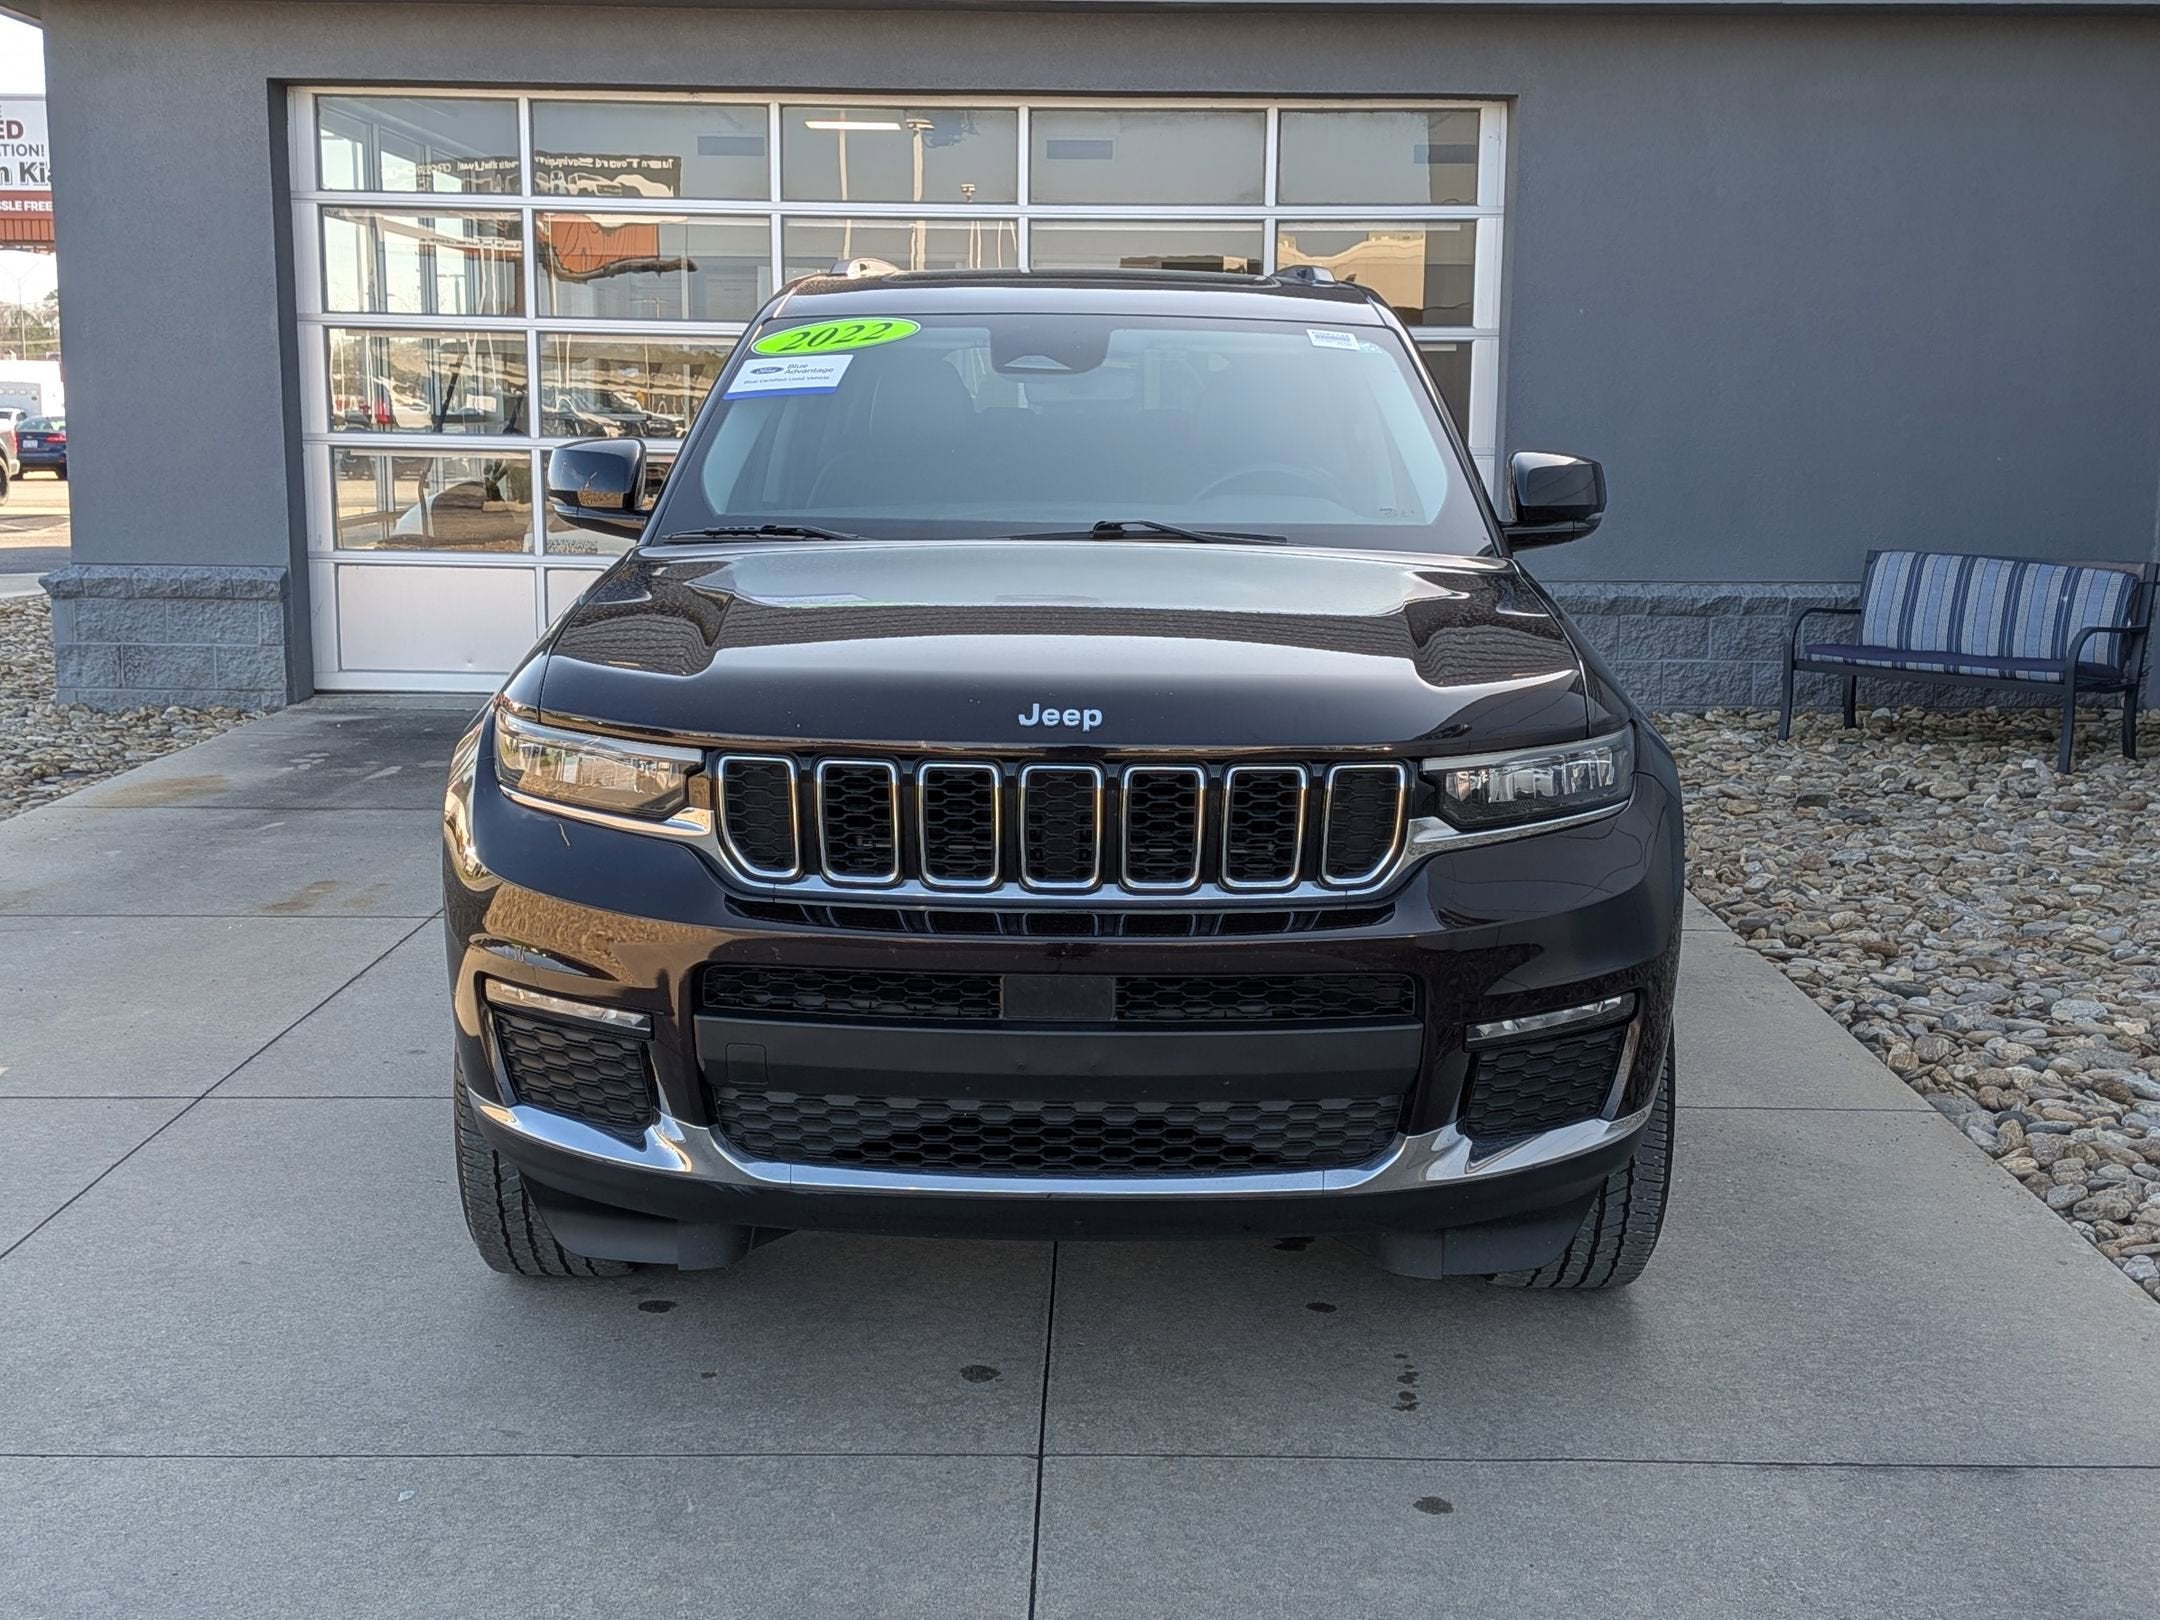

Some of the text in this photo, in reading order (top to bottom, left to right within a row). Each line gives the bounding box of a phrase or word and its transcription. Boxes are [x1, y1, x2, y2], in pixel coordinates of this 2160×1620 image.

[0, 143, 45, 157] TION!
[0, 200, 53, 212] SLE FREE
[775, 321, 893, 353] 2022
[784, 367, 834, 375] Advantage
[1018, 703, 1103, 732] Jeep
